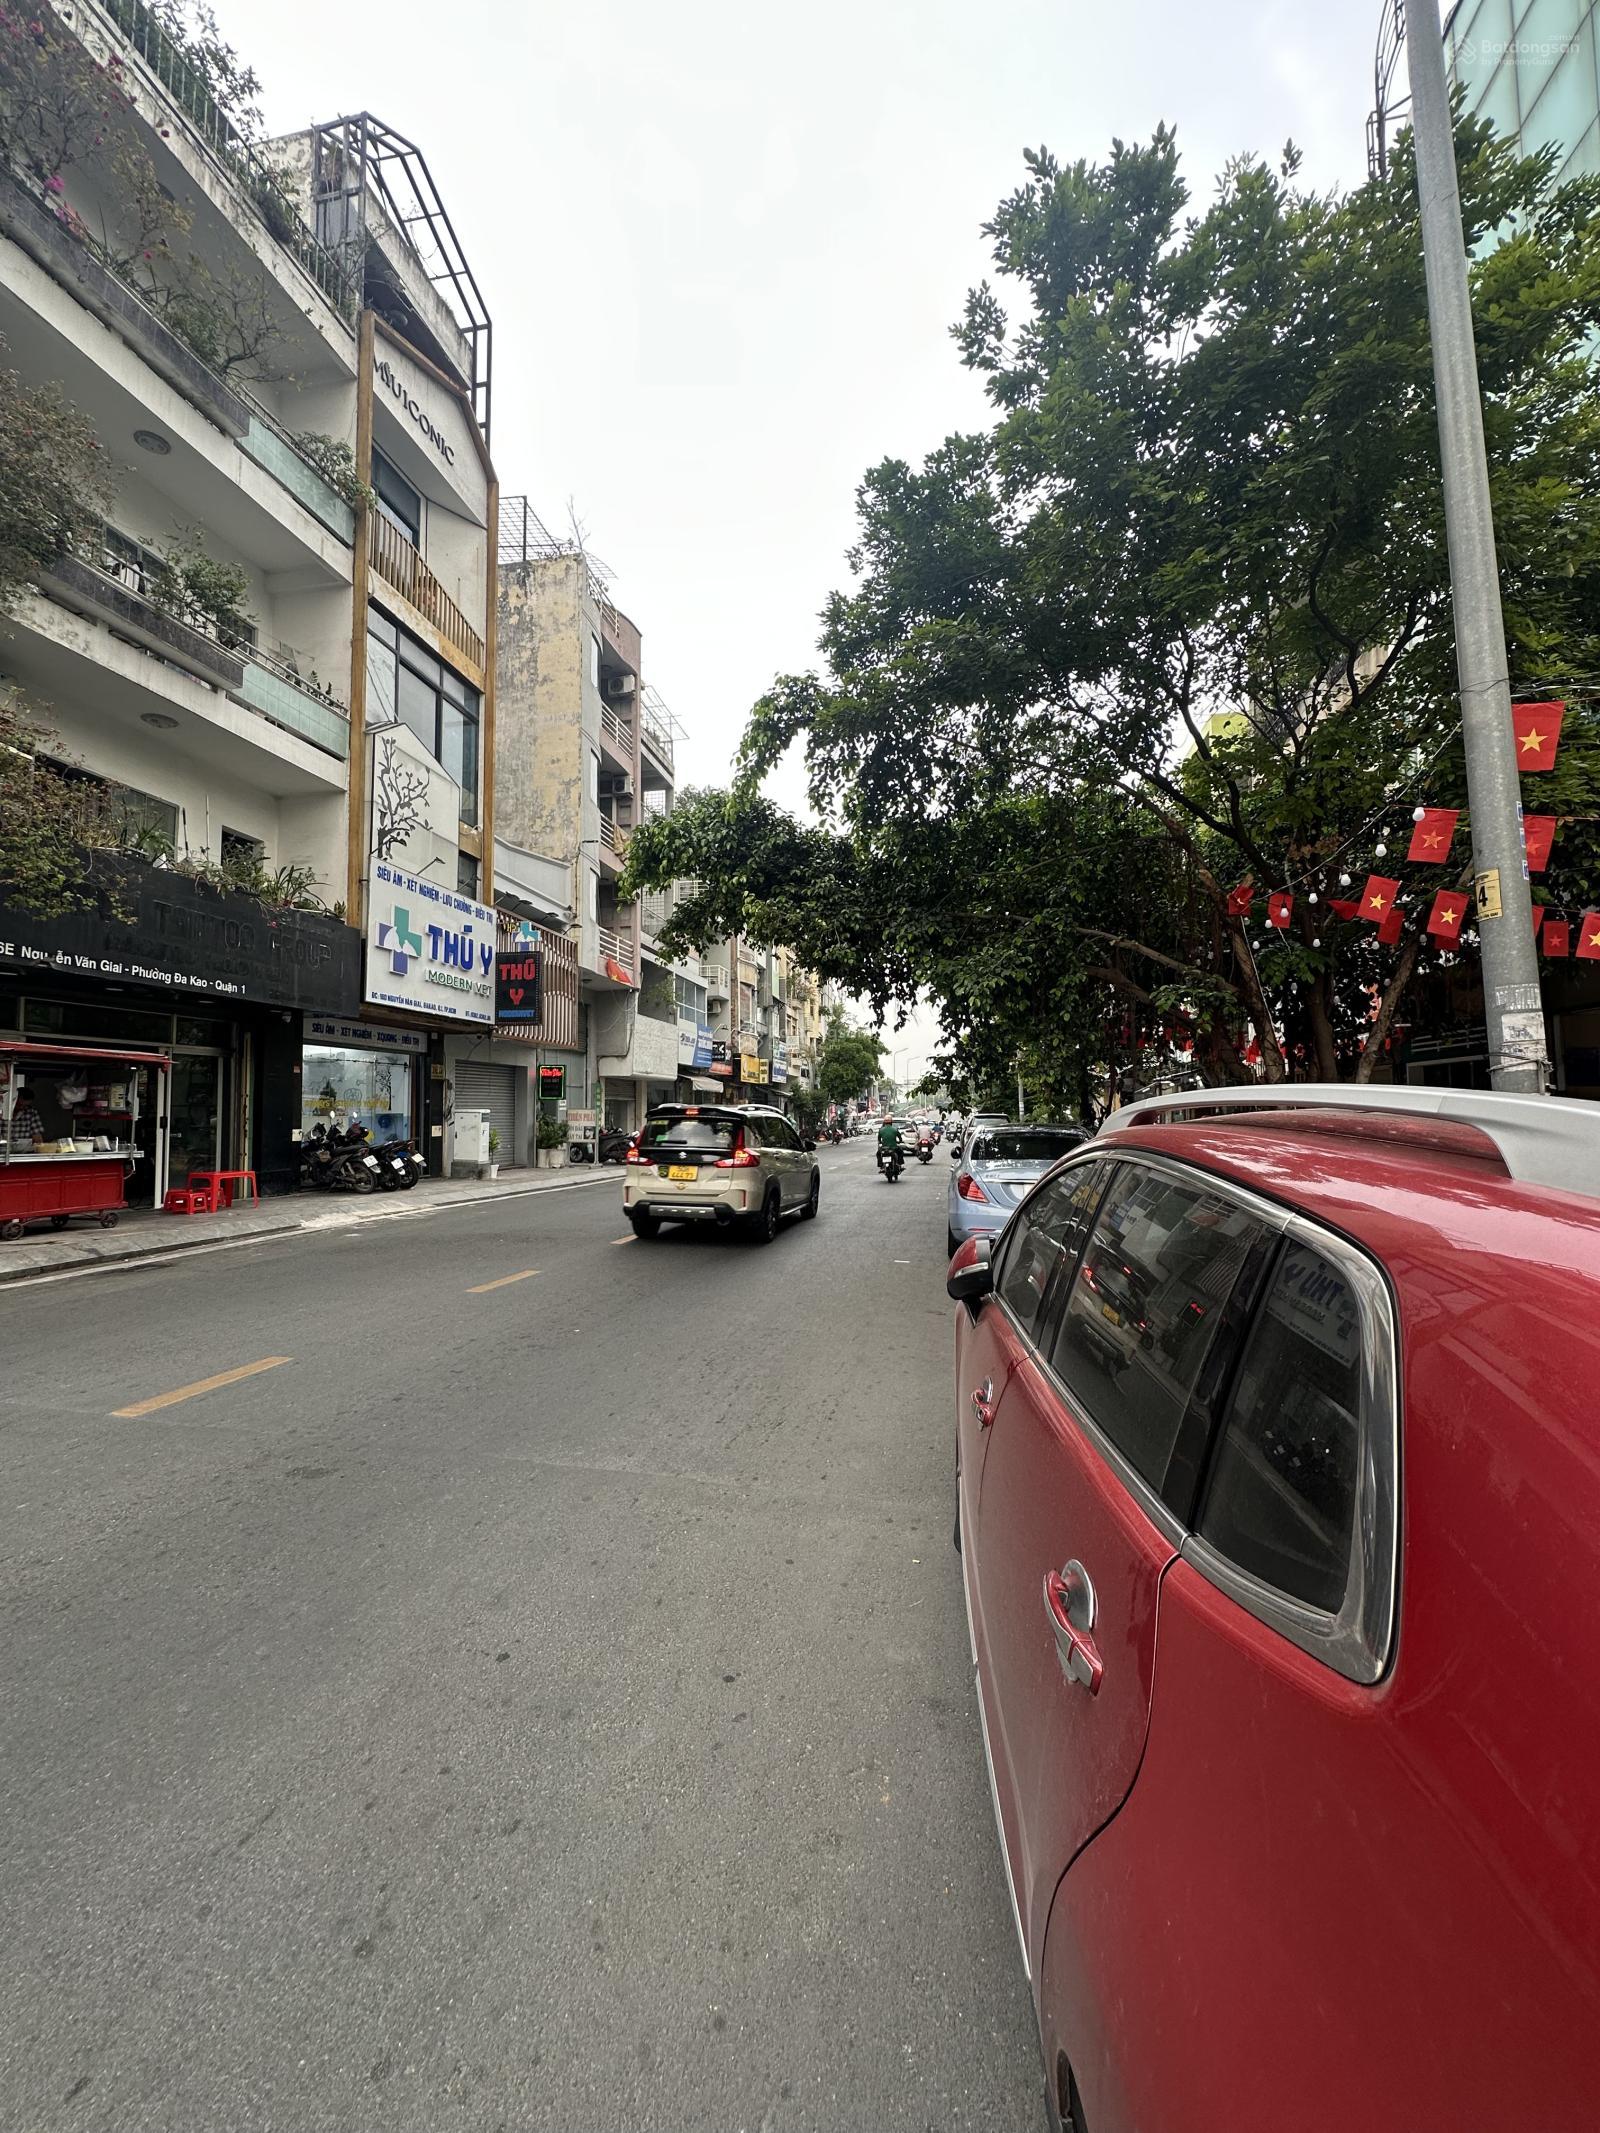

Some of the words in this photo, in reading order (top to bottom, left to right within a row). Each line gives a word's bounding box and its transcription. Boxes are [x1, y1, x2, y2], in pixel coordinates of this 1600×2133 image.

[376, 865, 391, 882] SIÊU
[1478, 885, 1488, 907] 4
[427, 923, 474, 971] THÚ
[480, 942, 493, 976] Y
[74, 954, 97, 970] Văn
[100, 960, 122, 974] Giai
[131, 965, 172, 984] Phường
[174, 972, 187, 985] Đa
[190, 976, 208, 988] Kao
[215, 980, 238, 994] Quận
[241, 985, 246, 995] 1
[428, 969, 473, 991] MODERN
